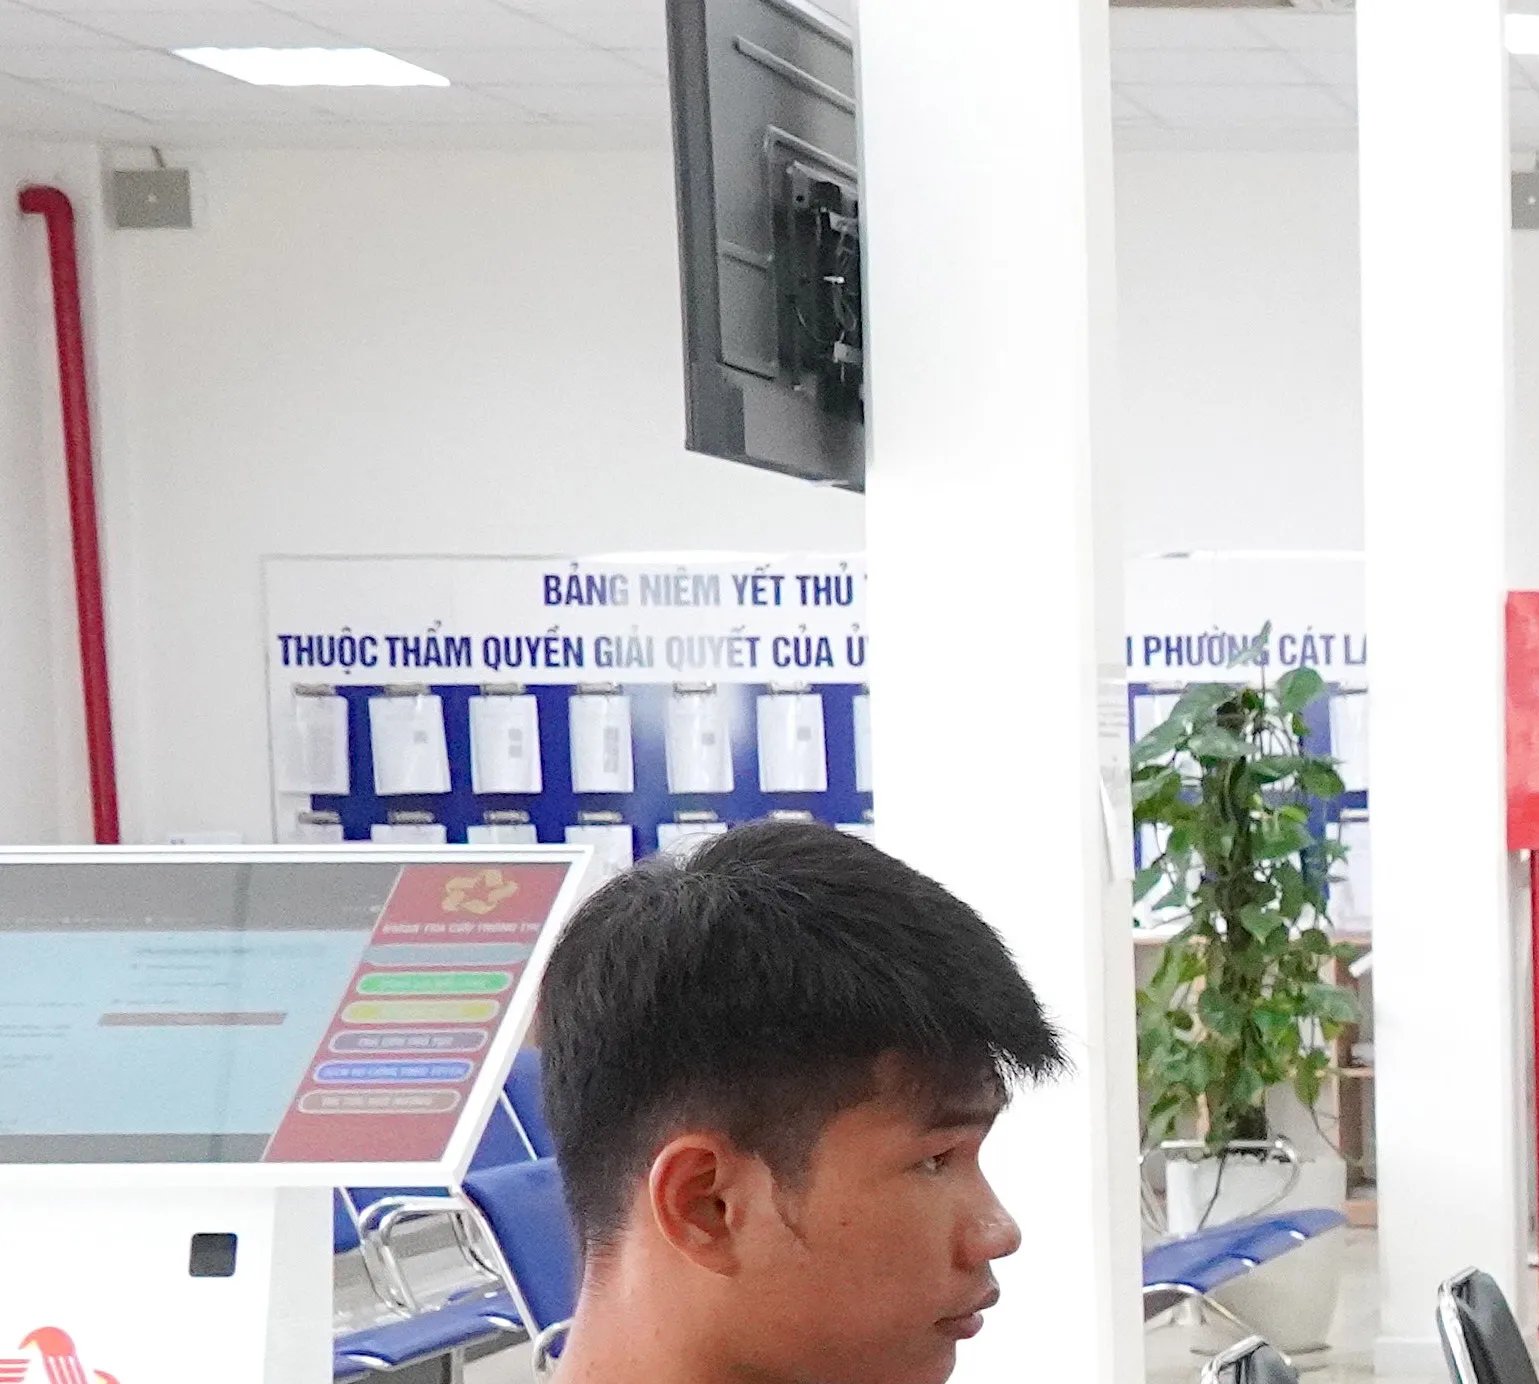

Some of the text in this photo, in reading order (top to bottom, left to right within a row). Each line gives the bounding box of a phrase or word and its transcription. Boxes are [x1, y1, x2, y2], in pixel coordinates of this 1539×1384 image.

[543, 560, 854, 607] BẢNG NIÊM YẾT THỦ
[277, 626, 378, 675] THUỘC
[384, 620, 473, 668] THẨM
[594, 624, 654, 668] GIẢI
[665, 624, 761, 672] QUYẾT
[772, 623, 834, 668] CỦA
[846, 622, 869, 668] Ủ
[1278, 624, 1336, 666] CÁT
